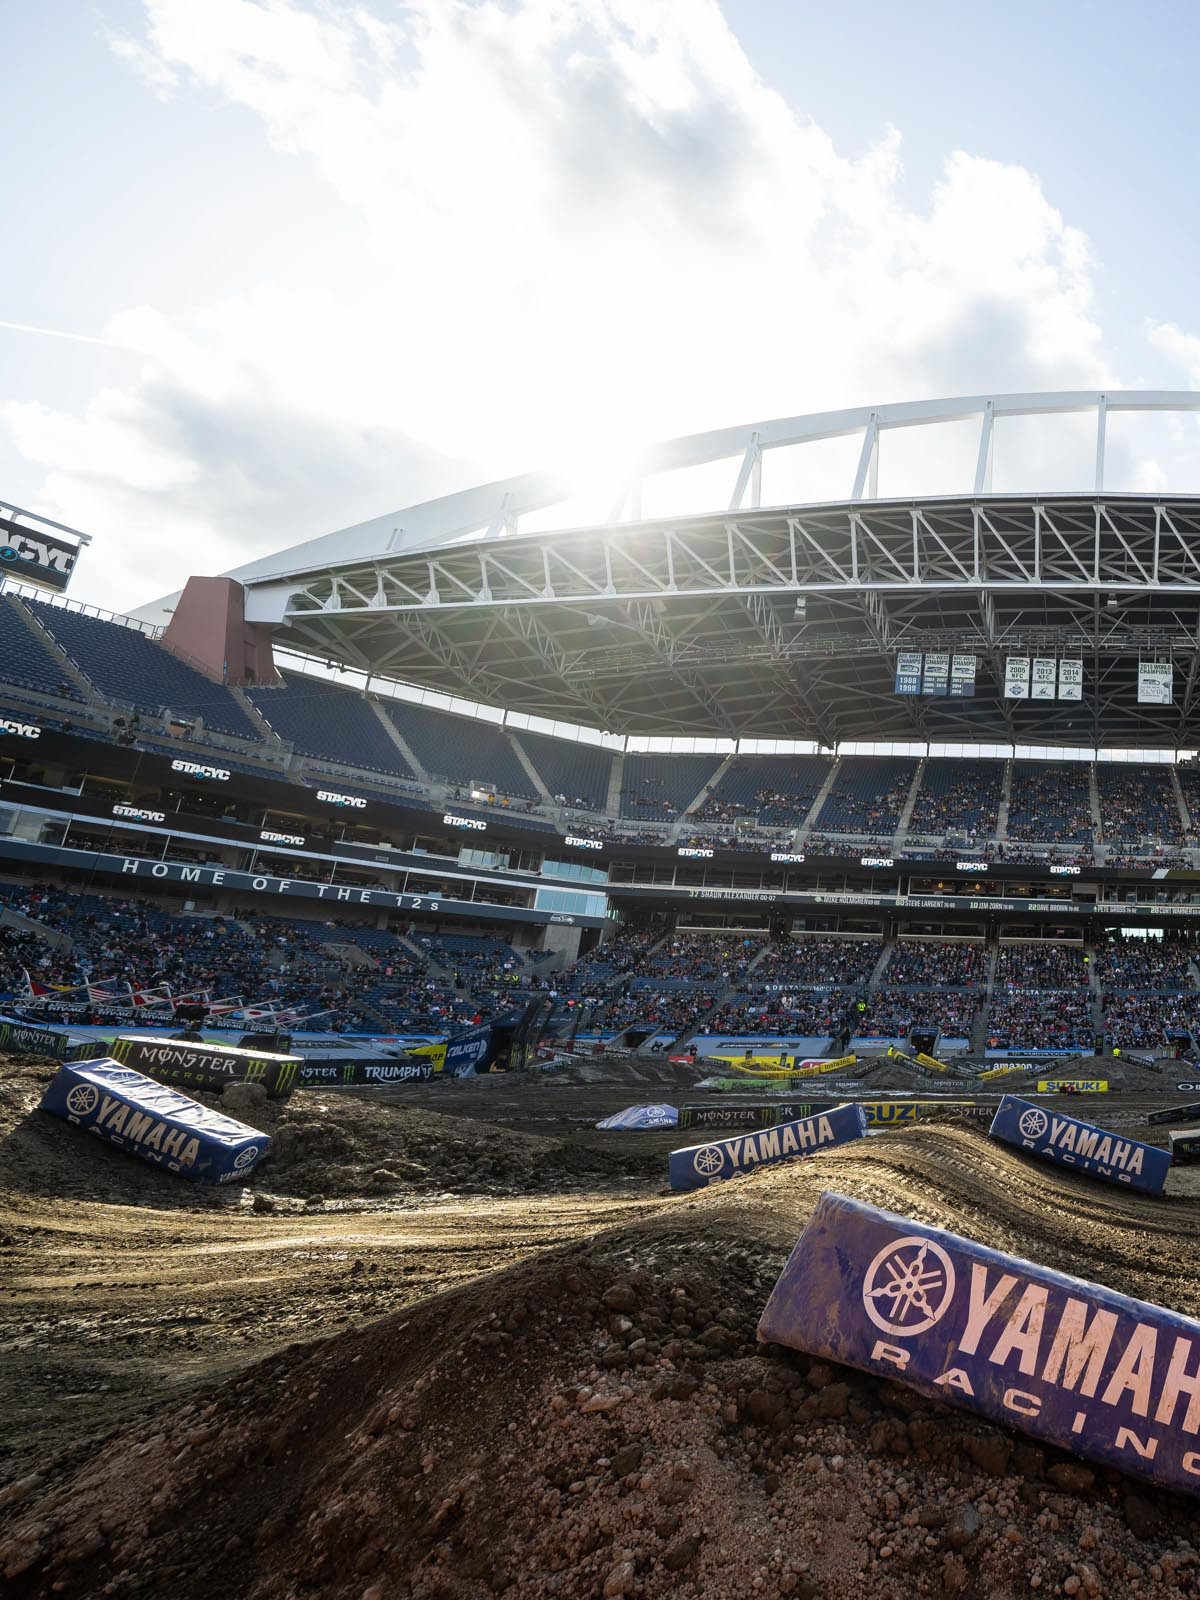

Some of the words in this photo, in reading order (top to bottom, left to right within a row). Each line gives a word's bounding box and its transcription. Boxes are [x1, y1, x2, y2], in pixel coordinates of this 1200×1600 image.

[172, 759, 231, 781] STACYC
[316, 790, 367, 809] STACYC
[112, 805, 165, 822] STACYC
[443, 815, 487, 831] STACYC
[260, 831, 305, 846] STACYC
[565, 836, 603, 849] STACYC
[678, 848, 714, 858] STACYC
[770, 853, 805, 863] STACYC
[861, 858, 894, 867] STACYC
[956, 862, 988, 871] STACYC
[1050, 866, 1081, 874] STACYC
[122, 858, 225, 886] HOME
[252, 878, 290, 894] OF
[317, 885, 371, 903] THE
[395, 896, 439, 912] 12s
[723, 892, 759, 900] ALEXANDER
[13, 1028, 56, 1048] MONSTER
[139, 1047, 236, 1075] MONSTER
[824, 1058, 851, 1070] Insta360
[993, 1062, 1032, 1070] amazon
[149, 1067, 216, 1082] ENERGY
[364, 1066, 420, 1078] TRIUMPH
[1046, 1081, 1101, 1092] SUZUKI
[697, 1110, 755, 1121] MONSTER
[866, 1104, 915, 1122] SUZ
[95, 1096, 201, 1169] YAMAHA
[725, 1116, 835, 1168] YAMAHA
[1049, 1117, 1145, 1175] YAMAHA
[1022, 1139, 1132, 1182] RACING
[220, 1164, 254, 1184] YAMAHA
